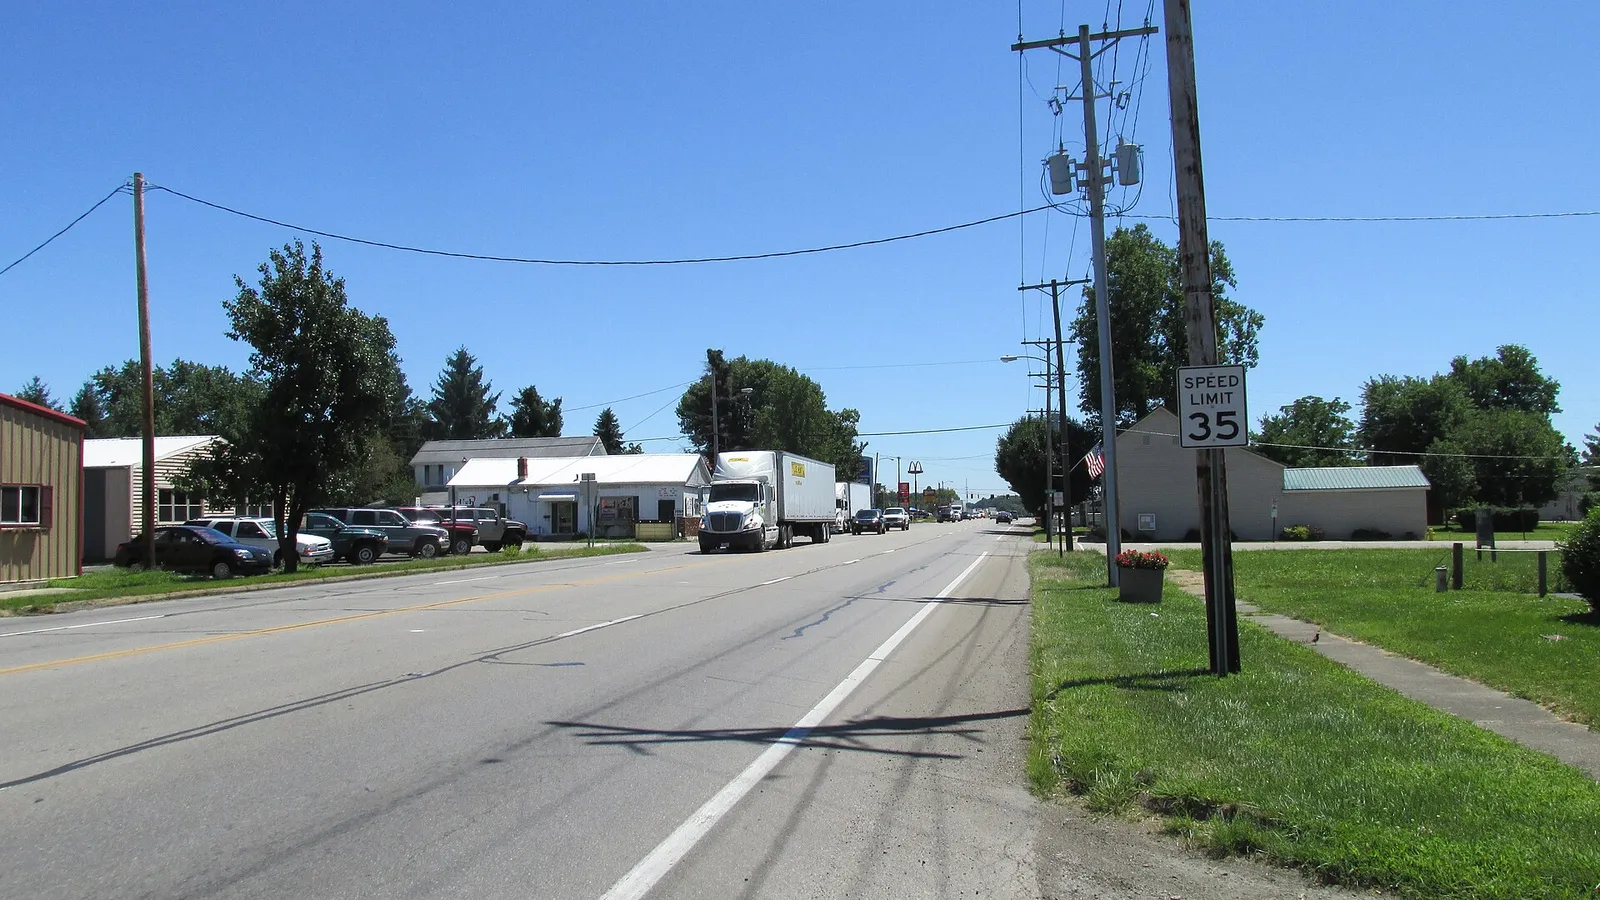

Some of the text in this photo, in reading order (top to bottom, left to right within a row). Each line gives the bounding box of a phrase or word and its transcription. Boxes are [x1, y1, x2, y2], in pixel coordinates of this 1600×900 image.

[1184, 375, 1239, 389] SPEED
[1190, 392, 1234, 406] LIMIT
[1188, 411, 1239, 441] 35
